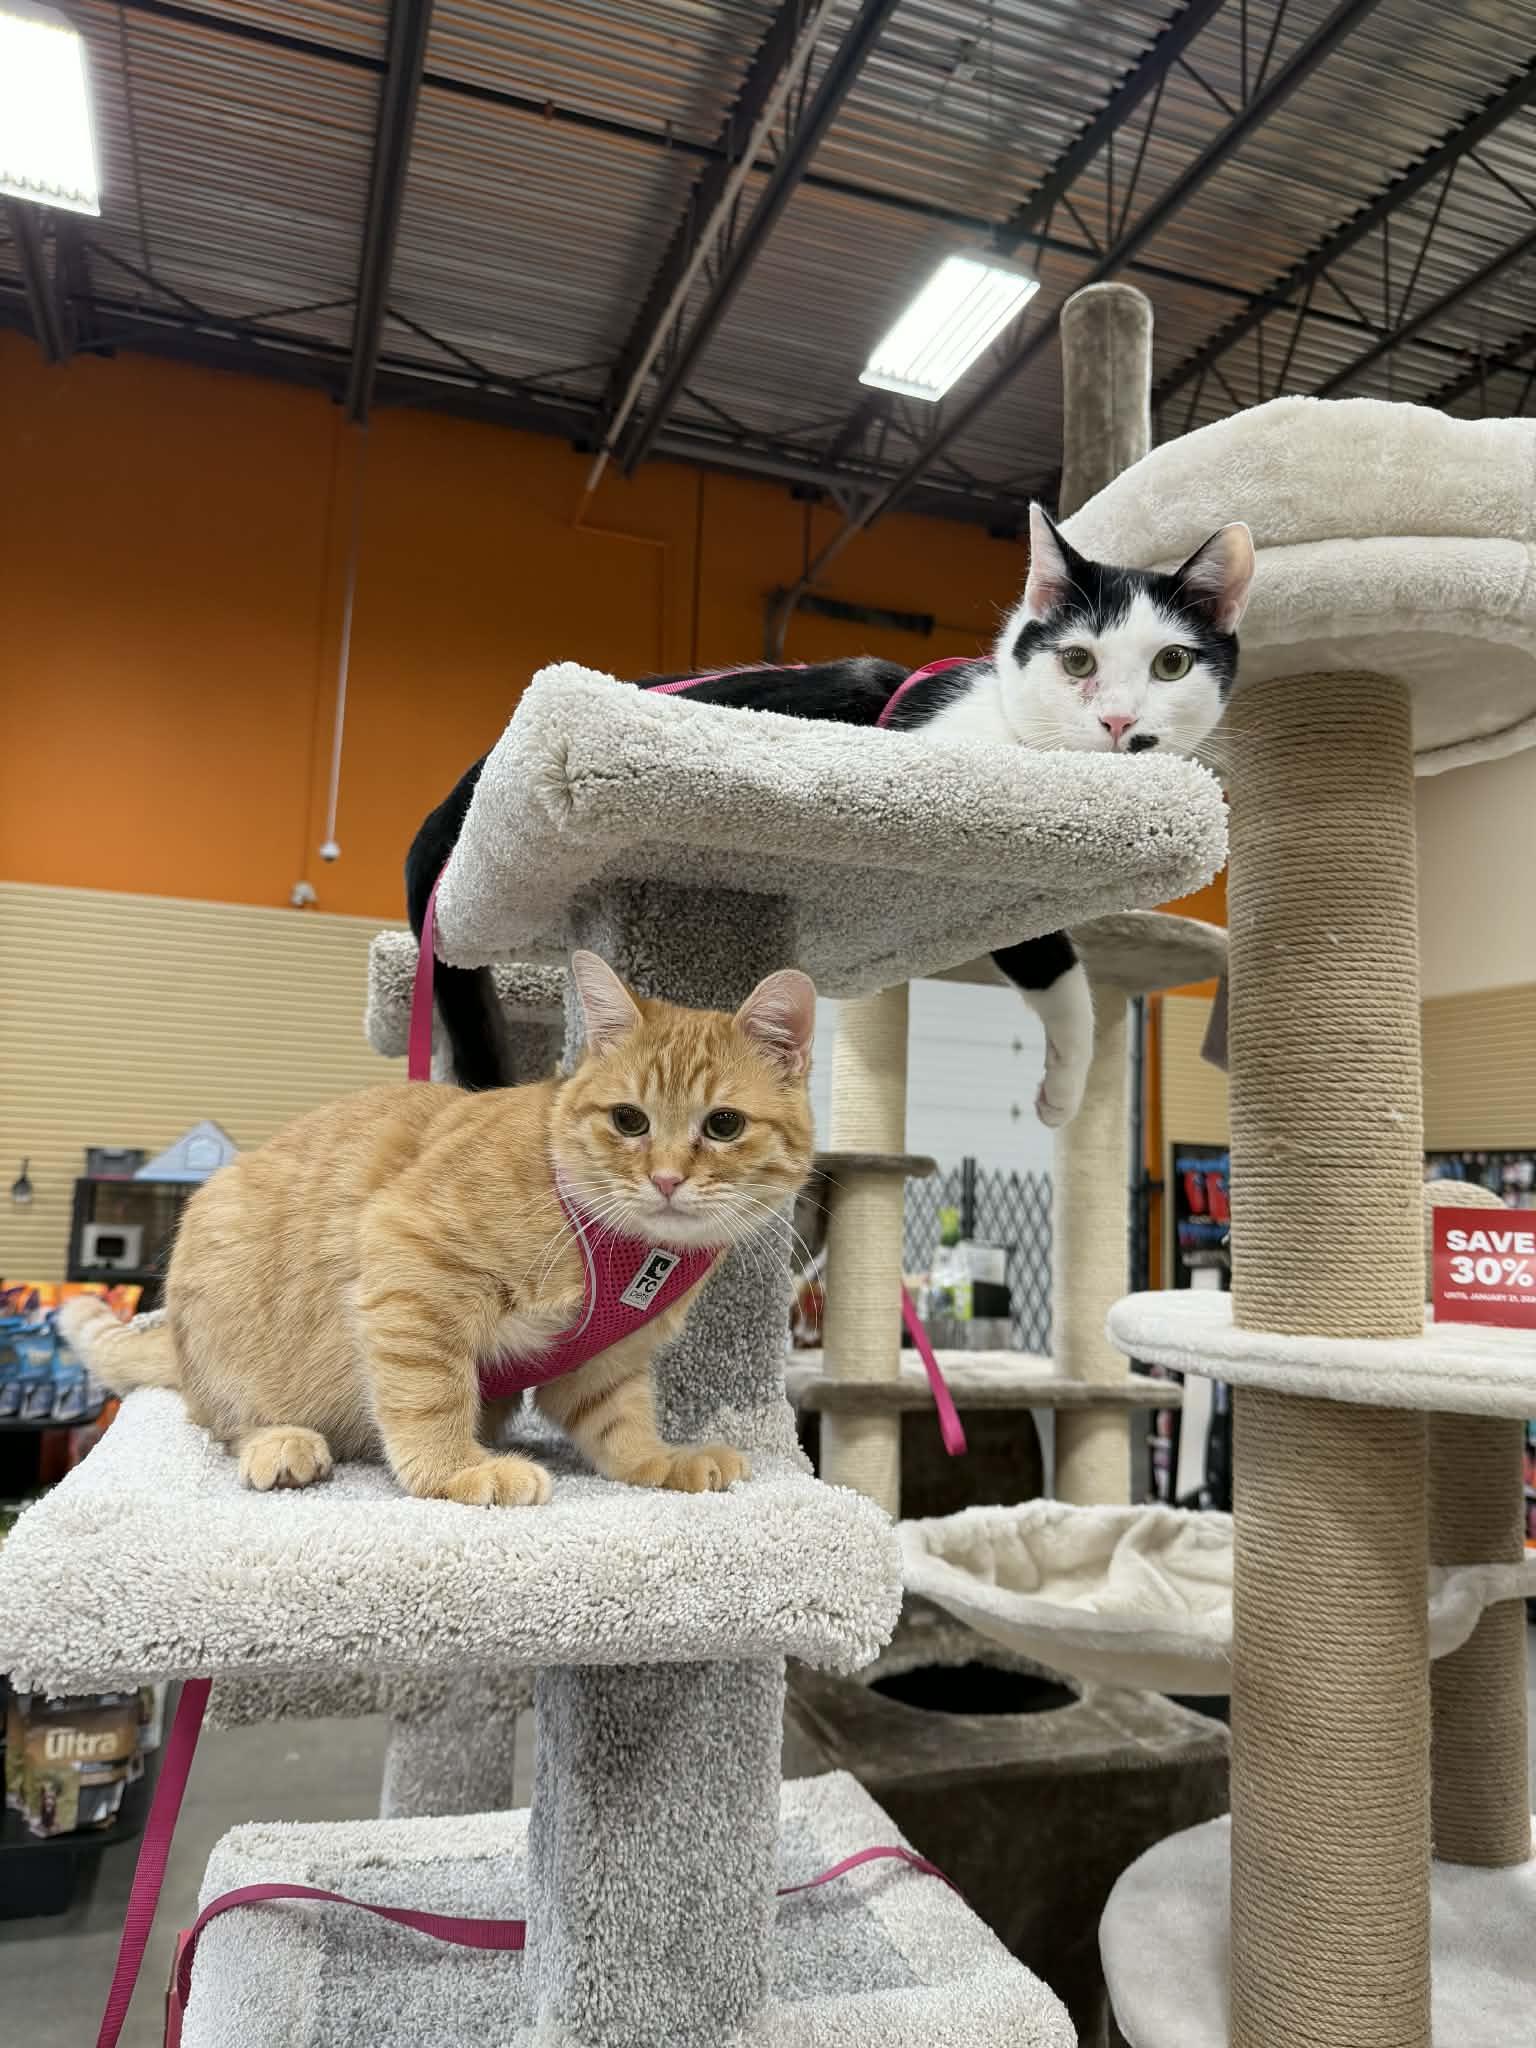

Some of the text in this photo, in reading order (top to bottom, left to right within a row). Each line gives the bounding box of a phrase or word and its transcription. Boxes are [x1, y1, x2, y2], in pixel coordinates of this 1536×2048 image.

[1446, 1229, 1535, 1254] SAVE
[1449, 1255, 1534, 1287] 30%
[1470, 1292, 1506, 1302] JANUARY
[45, 1727, 119, 1759] Ultra
